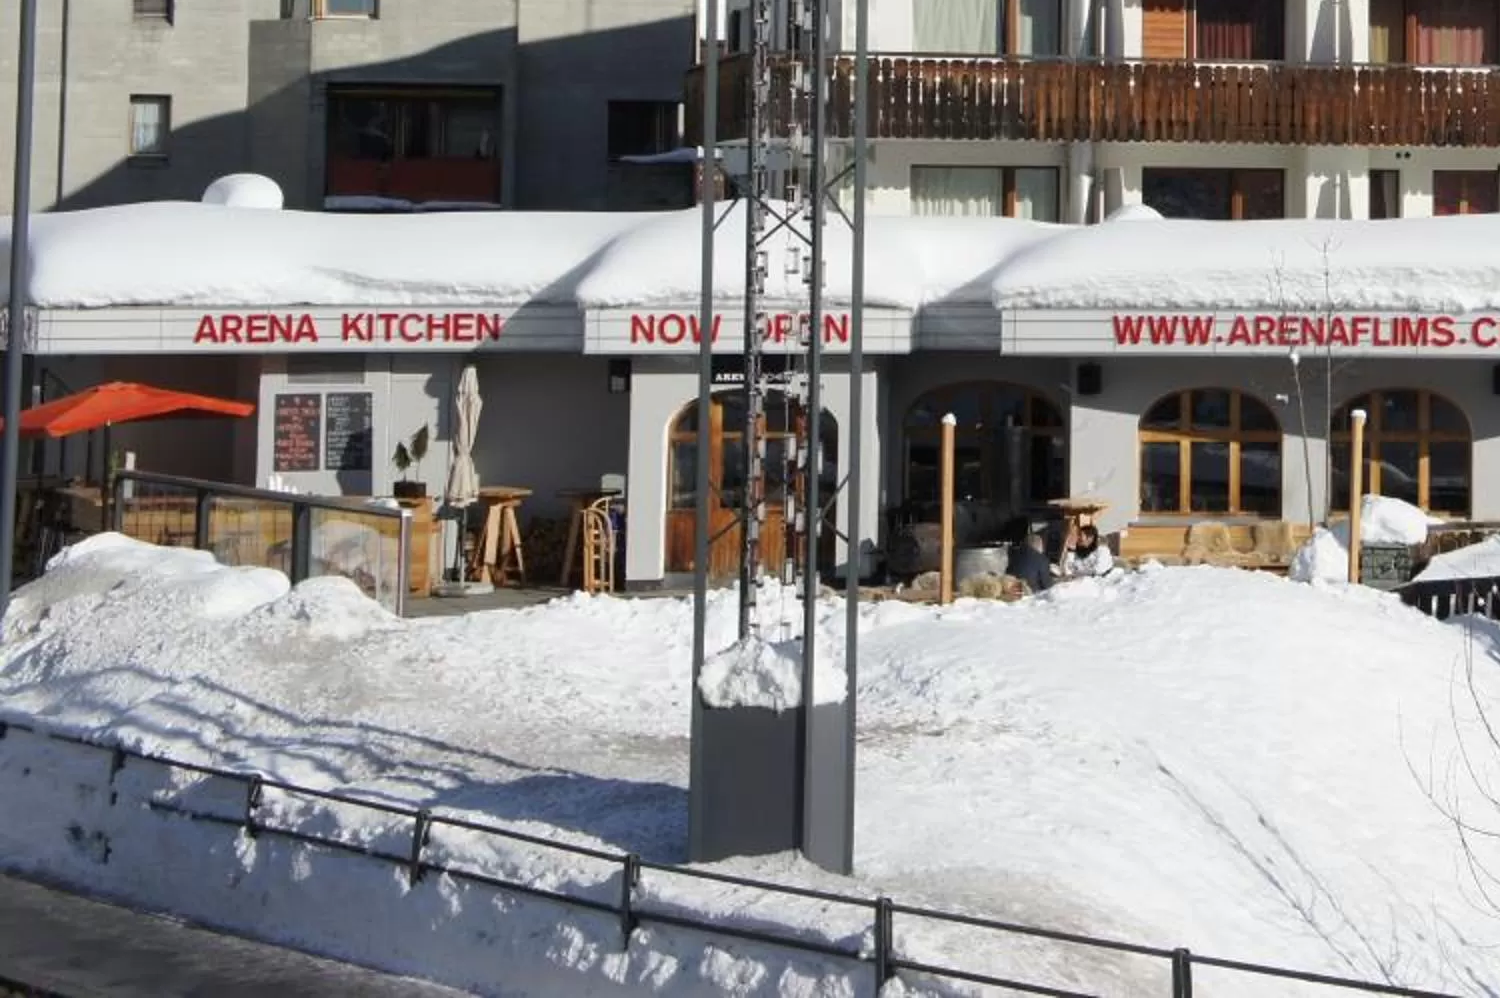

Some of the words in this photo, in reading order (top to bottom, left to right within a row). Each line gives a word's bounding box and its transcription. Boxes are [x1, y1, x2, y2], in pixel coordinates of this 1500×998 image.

[194, 313, 320, 344] ARENA
[341, 312, 502, 343] KITCHEN
[631, 313, 722, 345] NOW
